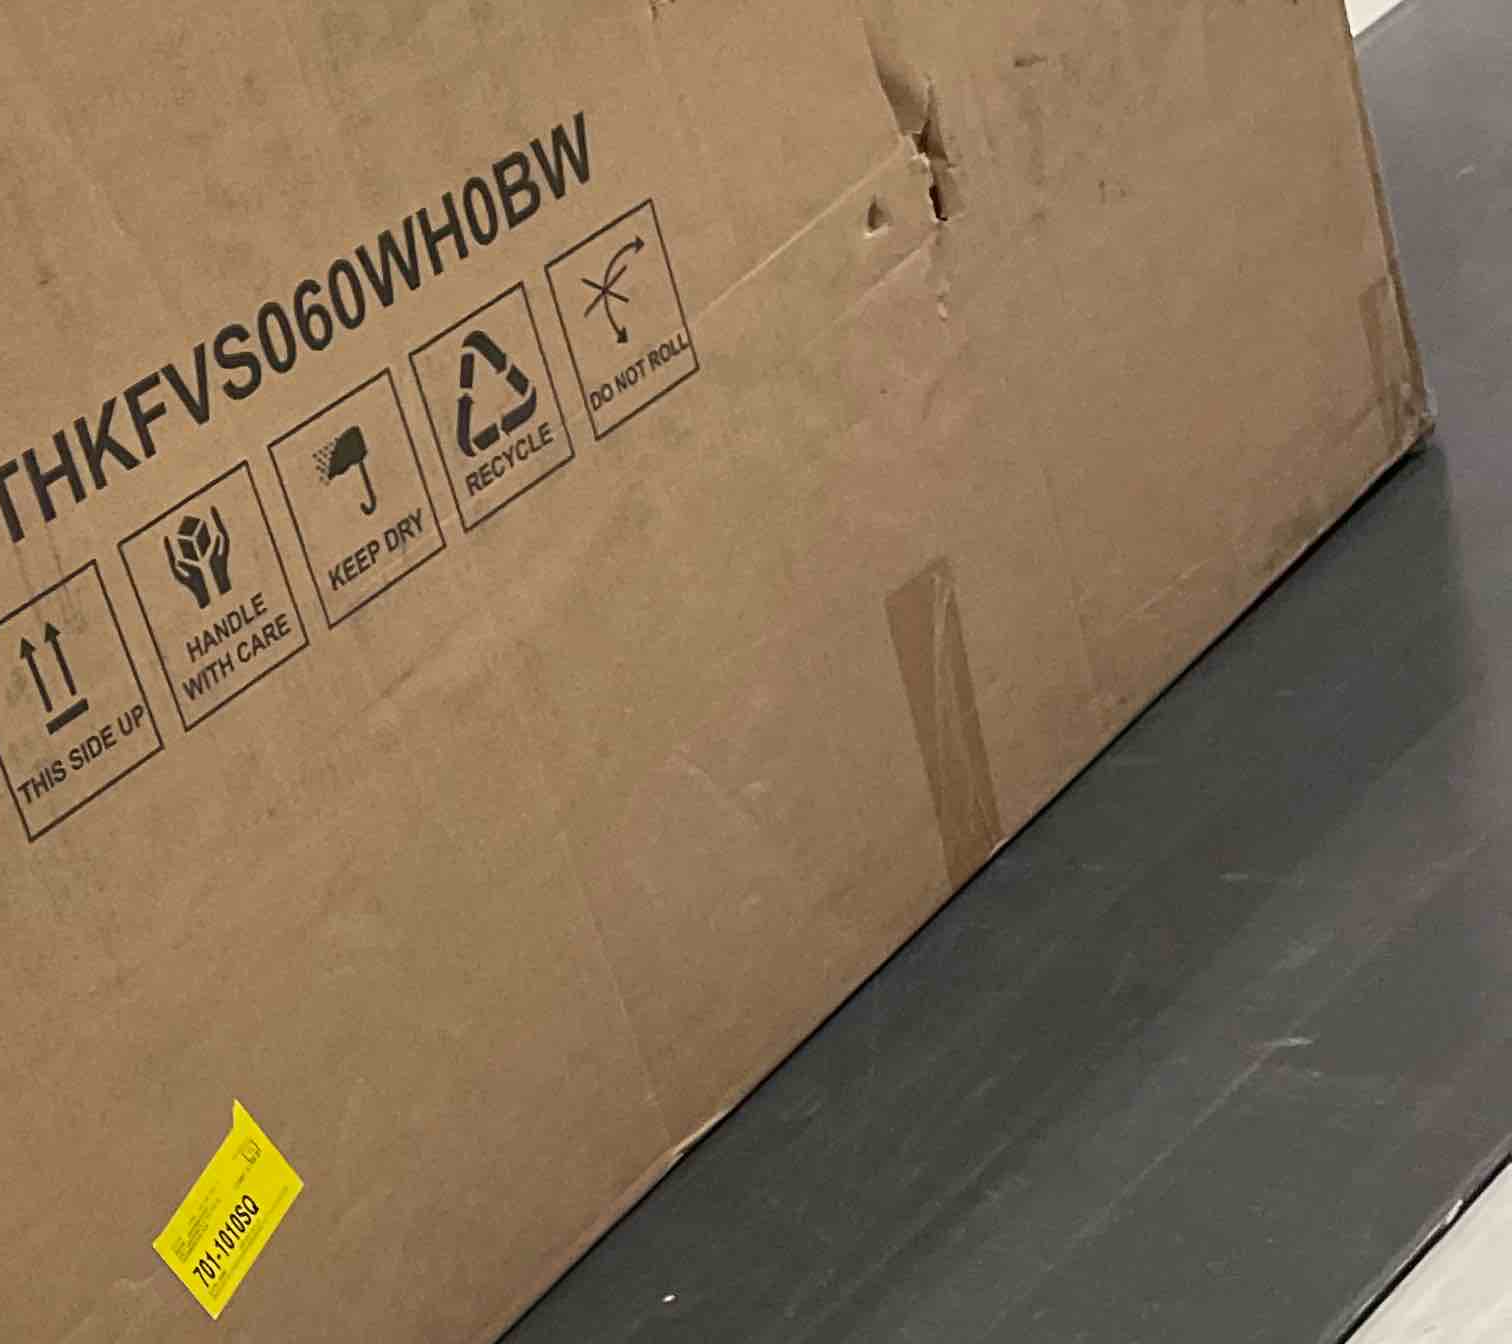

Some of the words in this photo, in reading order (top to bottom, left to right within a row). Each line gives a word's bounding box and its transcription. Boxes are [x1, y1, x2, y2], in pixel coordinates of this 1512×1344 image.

[589, 384, 614, 411] DO
[614, 358, 647, 393] NOT
[647, 333, 690, 372] ROLL
[465, 422, 555, 497] RECYCLE
[327, 540, 381, 592] KEEP
[383, 508, 426, 553] DRY
[182, 652, 236, 701] WITH
[237, 613, 292, 664] CARE
[186, 592, 268, 663] HANDLE
[17, 760, 68, 805] THIS
[68, 724, 118, 771] SIDE
[117, 704, 145, 737] UP
[192, 1194, 260, 1288] 701-1010SQ
